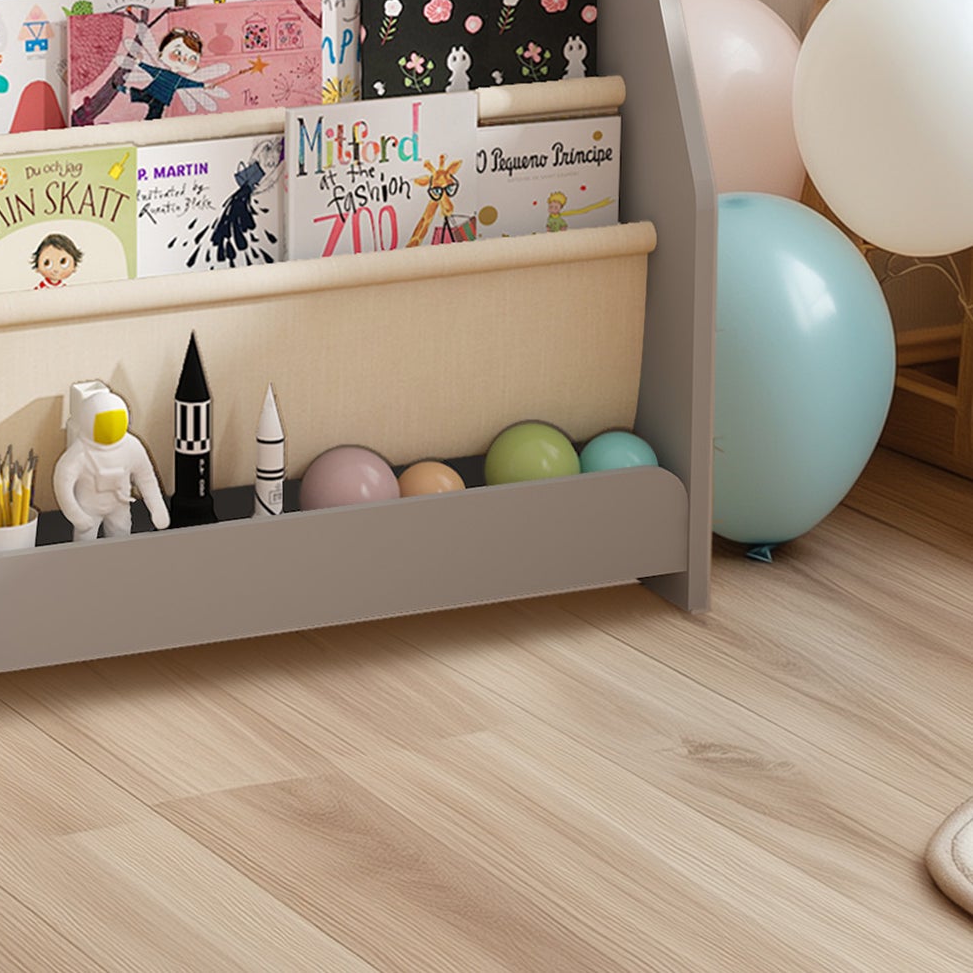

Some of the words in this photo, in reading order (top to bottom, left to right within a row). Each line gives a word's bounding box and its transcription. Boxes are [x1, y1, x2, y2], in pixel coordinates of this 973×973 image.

[242, 89, 259, 106] The
[296, 102, 422, 177] Mitford
[25, 165, 41, 180] Du
[44, 161, 61, 176] och
[60, 161, 83, 178] jag
[154, 162, 209, 179] MARTIN
[346, 162, 376, 184] the
[491, 147, 548, 177] Pequeno
[44, 180, 130, 224] SKATT
[328, 176, 411, 223] fashion
